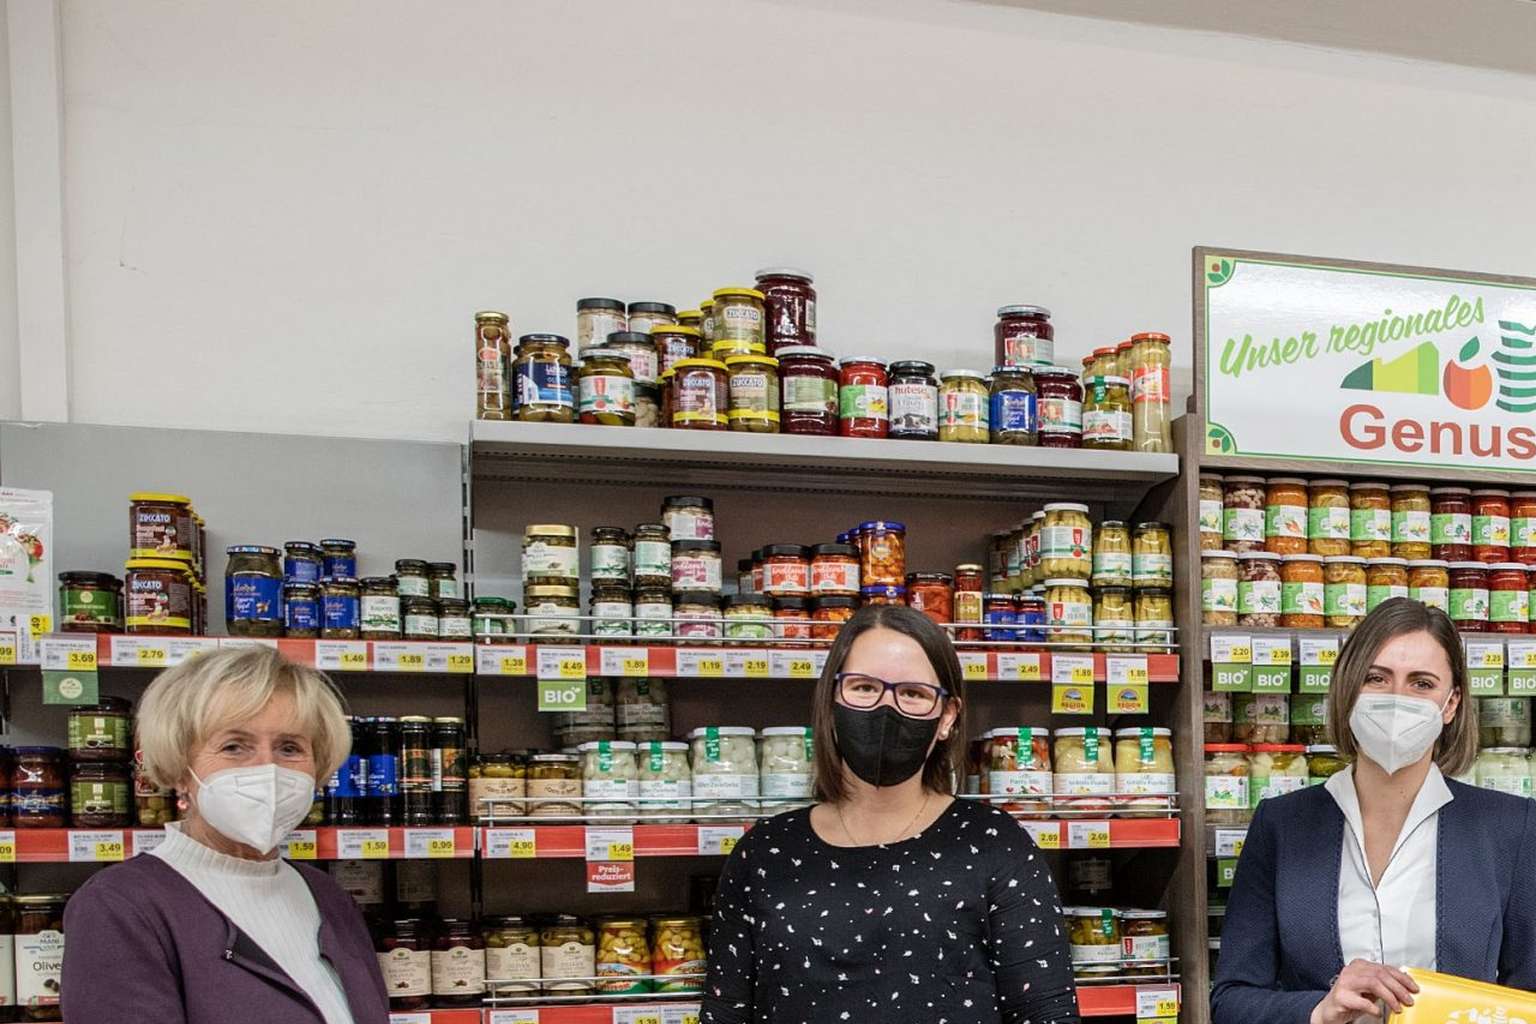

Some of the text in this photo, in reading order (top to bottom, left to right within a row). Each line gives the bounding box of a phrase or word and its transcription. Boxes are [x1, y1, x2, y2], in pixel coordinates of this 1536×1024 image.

[1220, 294, 1484, 377] Unser regionales
[71, 654, 94, 663] 3.69
[140, 650, 164, 659] 2.79
[343, 655, 364, 664] 1.49
[451, 656, 471, 665] 1.29
[746, 660, 766, 671] 2.19
[562, 661, 583, 671] 4.49
[701, 661, 721, 671] 1.19
[791, 661, 811, 672] 2.49
[1217, 671, 1243, 685] BIO
[1257, 673, 1283, 687] BIO
[1305, 673, 1330, 686] BIO
[1471, 677, 1495, 689] BIO
[1513, 677, 1536, 689] BIO
[544, 689, 576, 704] BIO
[99, 844, 121, 853] 3.49
[366, 842, 386, 850] 1.59
[513, 841, 533, 850] 4.90
[598, 865, 624, 875] Preis-
[591, 871, 633, 882] reduziert
